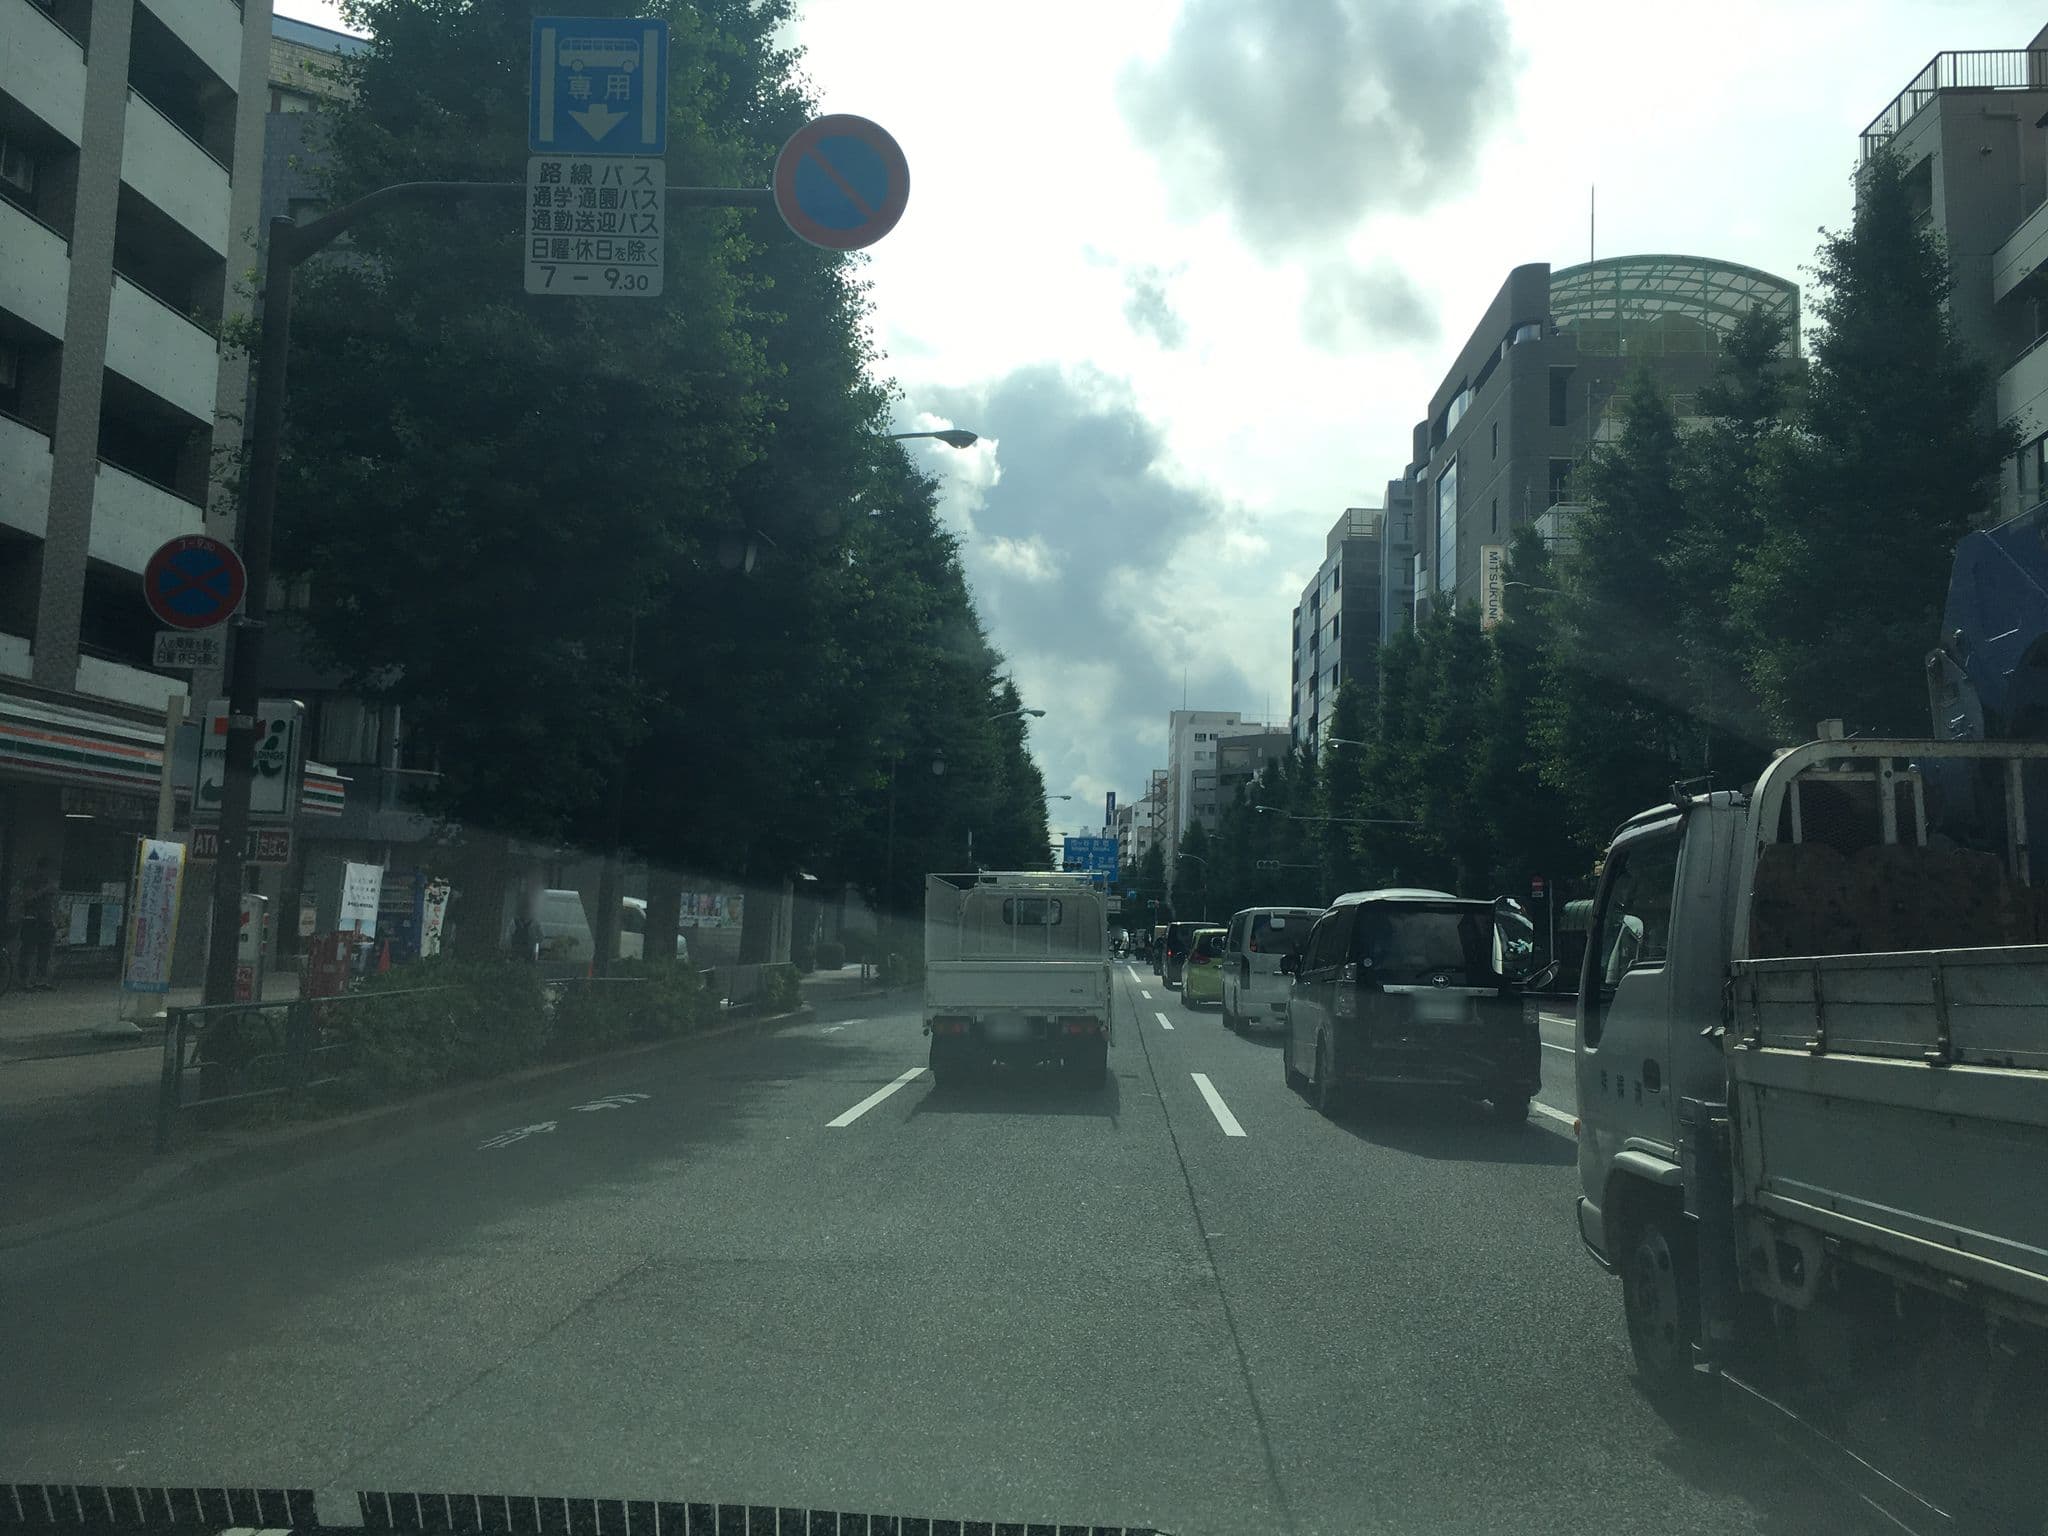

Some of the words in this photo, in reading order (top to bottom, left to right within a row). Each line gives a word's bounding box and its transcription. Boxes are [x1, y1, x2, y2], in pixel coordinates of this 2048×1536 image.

[568, 74, 630, 101] 専用
[540, 162, 653, 186] 路線バス
[532, 210, 658, 234] 通勤送迎バス
